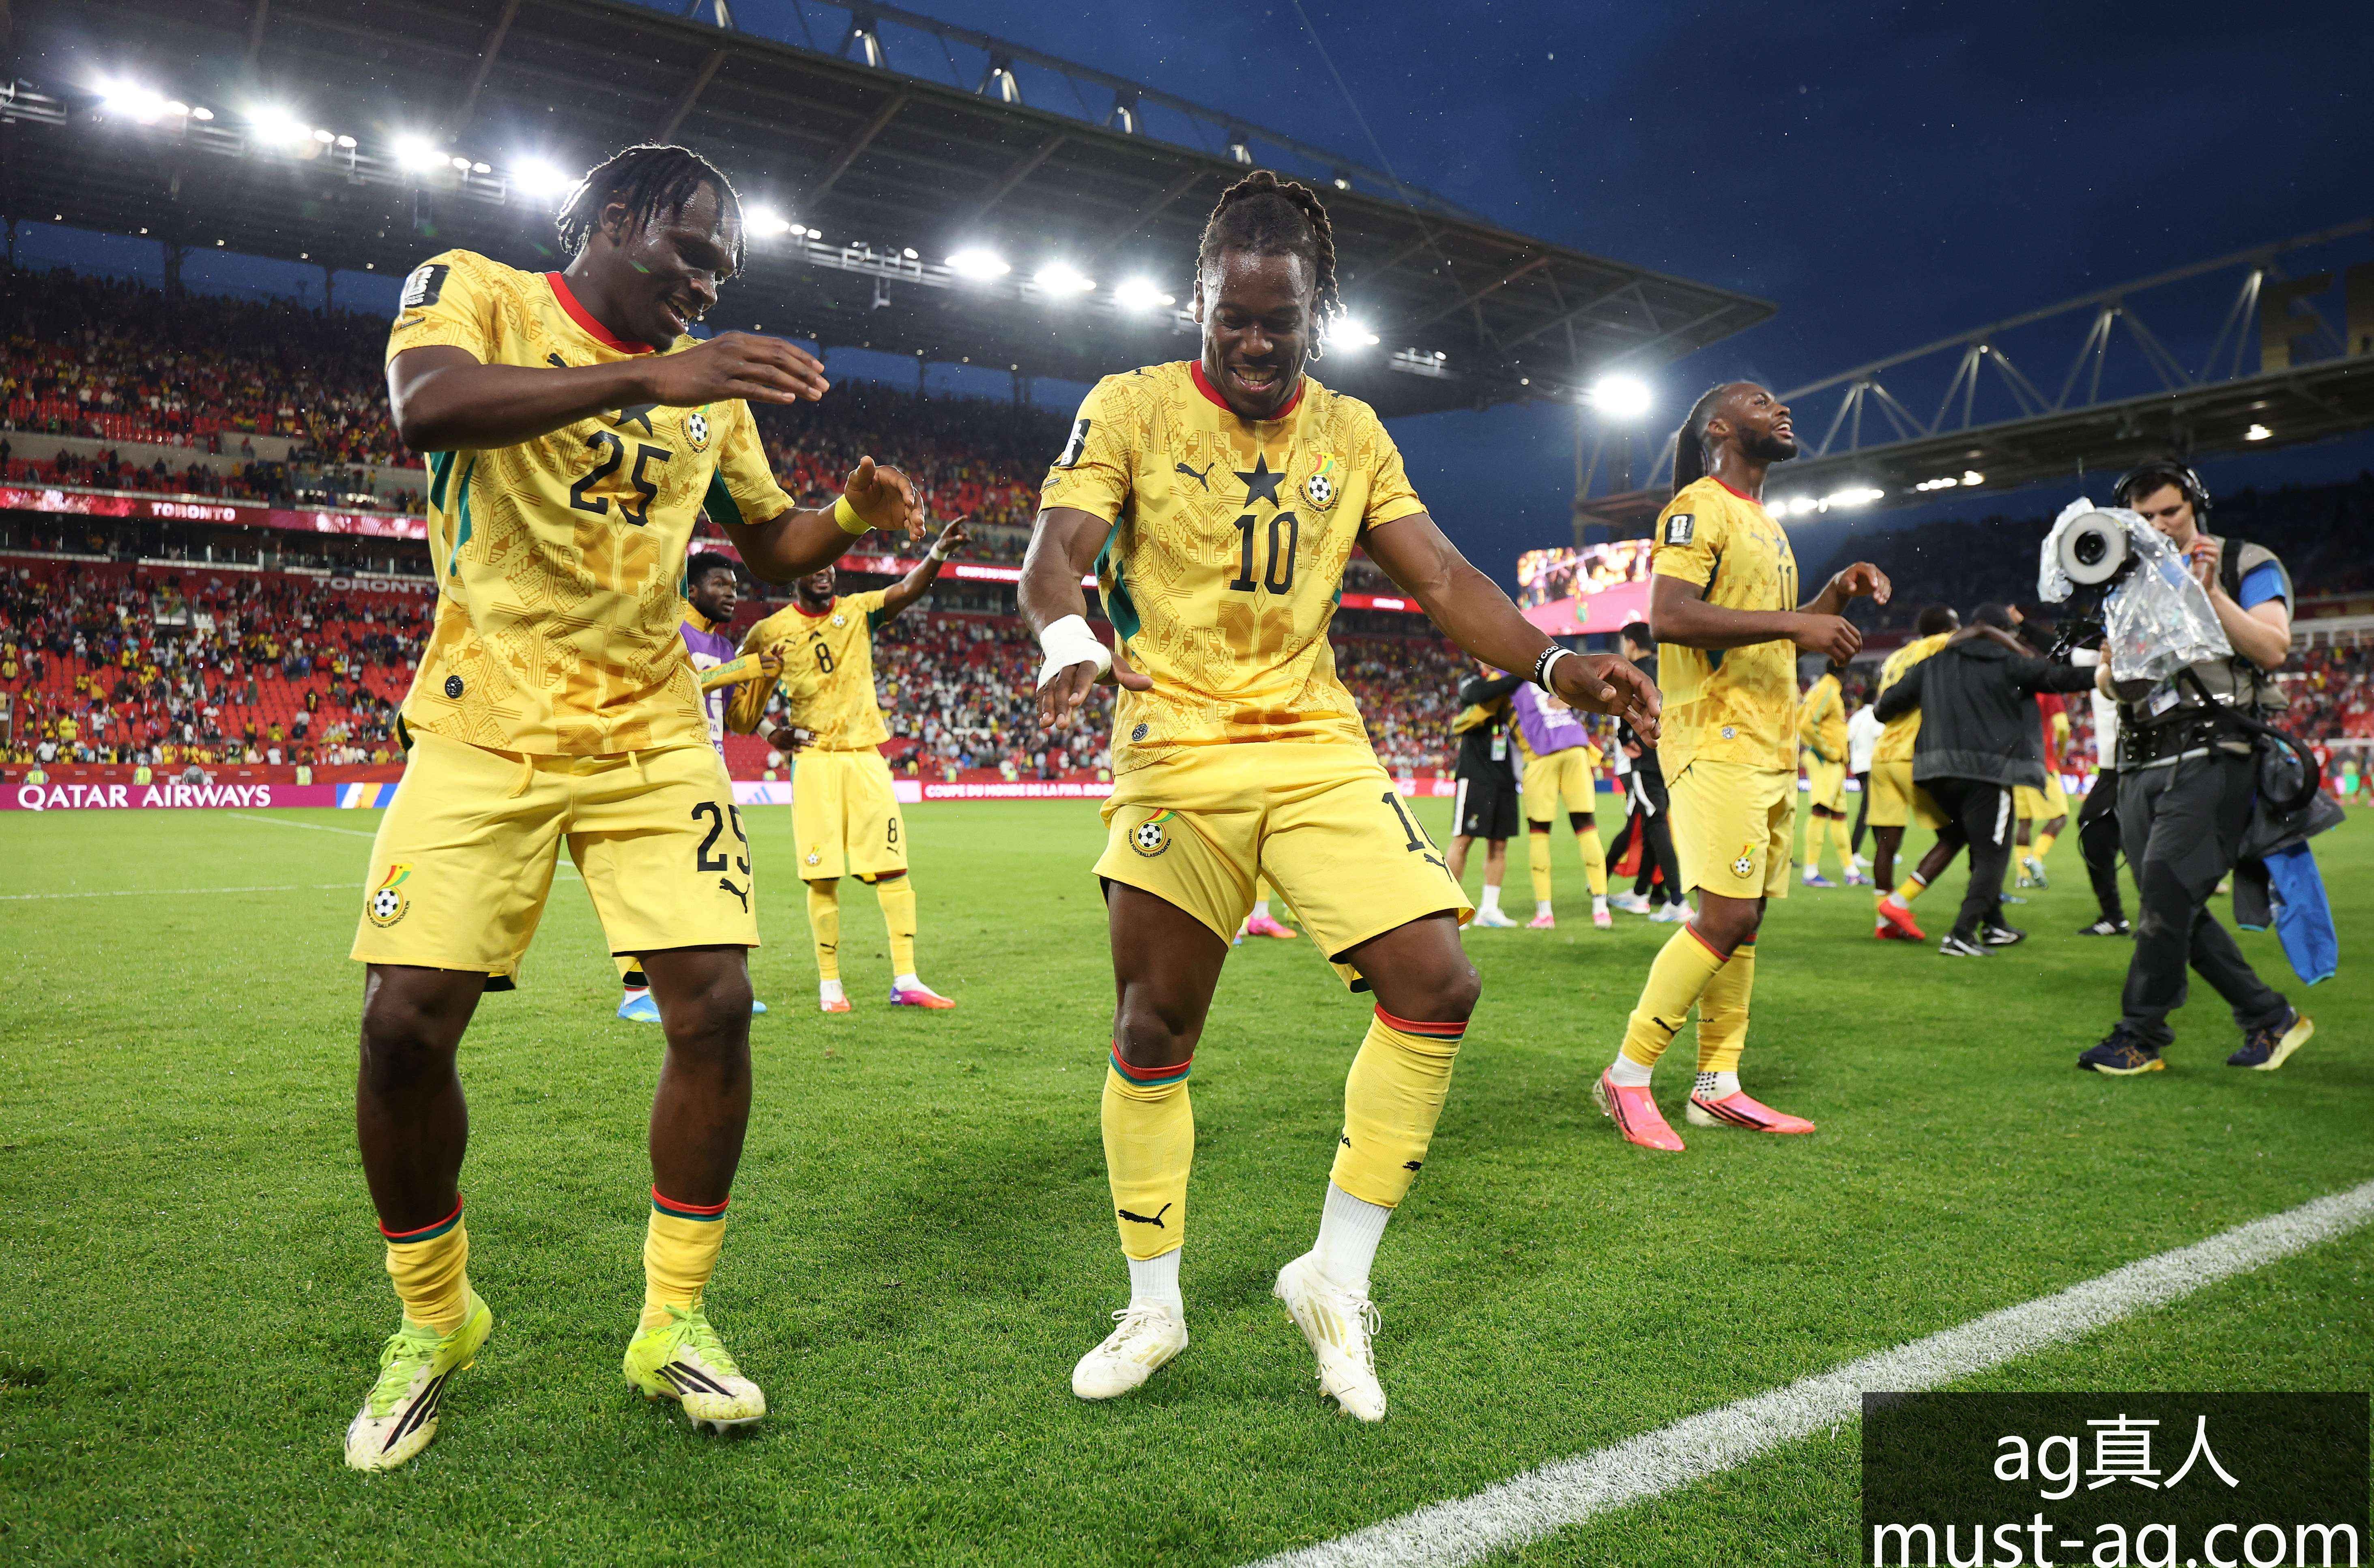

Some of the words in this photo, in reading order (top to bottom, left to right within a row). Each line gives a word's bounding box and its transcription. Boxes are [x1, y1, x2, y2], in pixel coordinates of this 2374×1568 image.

[570, 430, 673, 527] 25
[151, 502, 235, 521] TORONTO
[1306, 500, 1324, 512] FOOTBALL
[1229, 511, 1298, 595] 10
[1778, 564, 1793, 611] 11
[815, 643, 834, 674] 8
[1535, 659, 1543, 670] IN
[1540, 645, 1560, 659] GOD
[17, 784, 129, 811] QATAR
[142, 784, 271, 808] AIRWAYS
[924, 784, 966, 798] COUPE
[967, 784, 984, 798] DU
[984, 784, 1025, 798] MONDE
[1026, 783, 1042, 797] DE
[1042, 783, 1058, 797] LA
[1057, 783, 1083, 797] FIFA
[691, 801, 751, 875] 25
[887, 817, 898, 843] 8
[1131, 844, 1150, 857] FOOTBALL
[1150, 838, 1171, 857] ASSOCIATION
